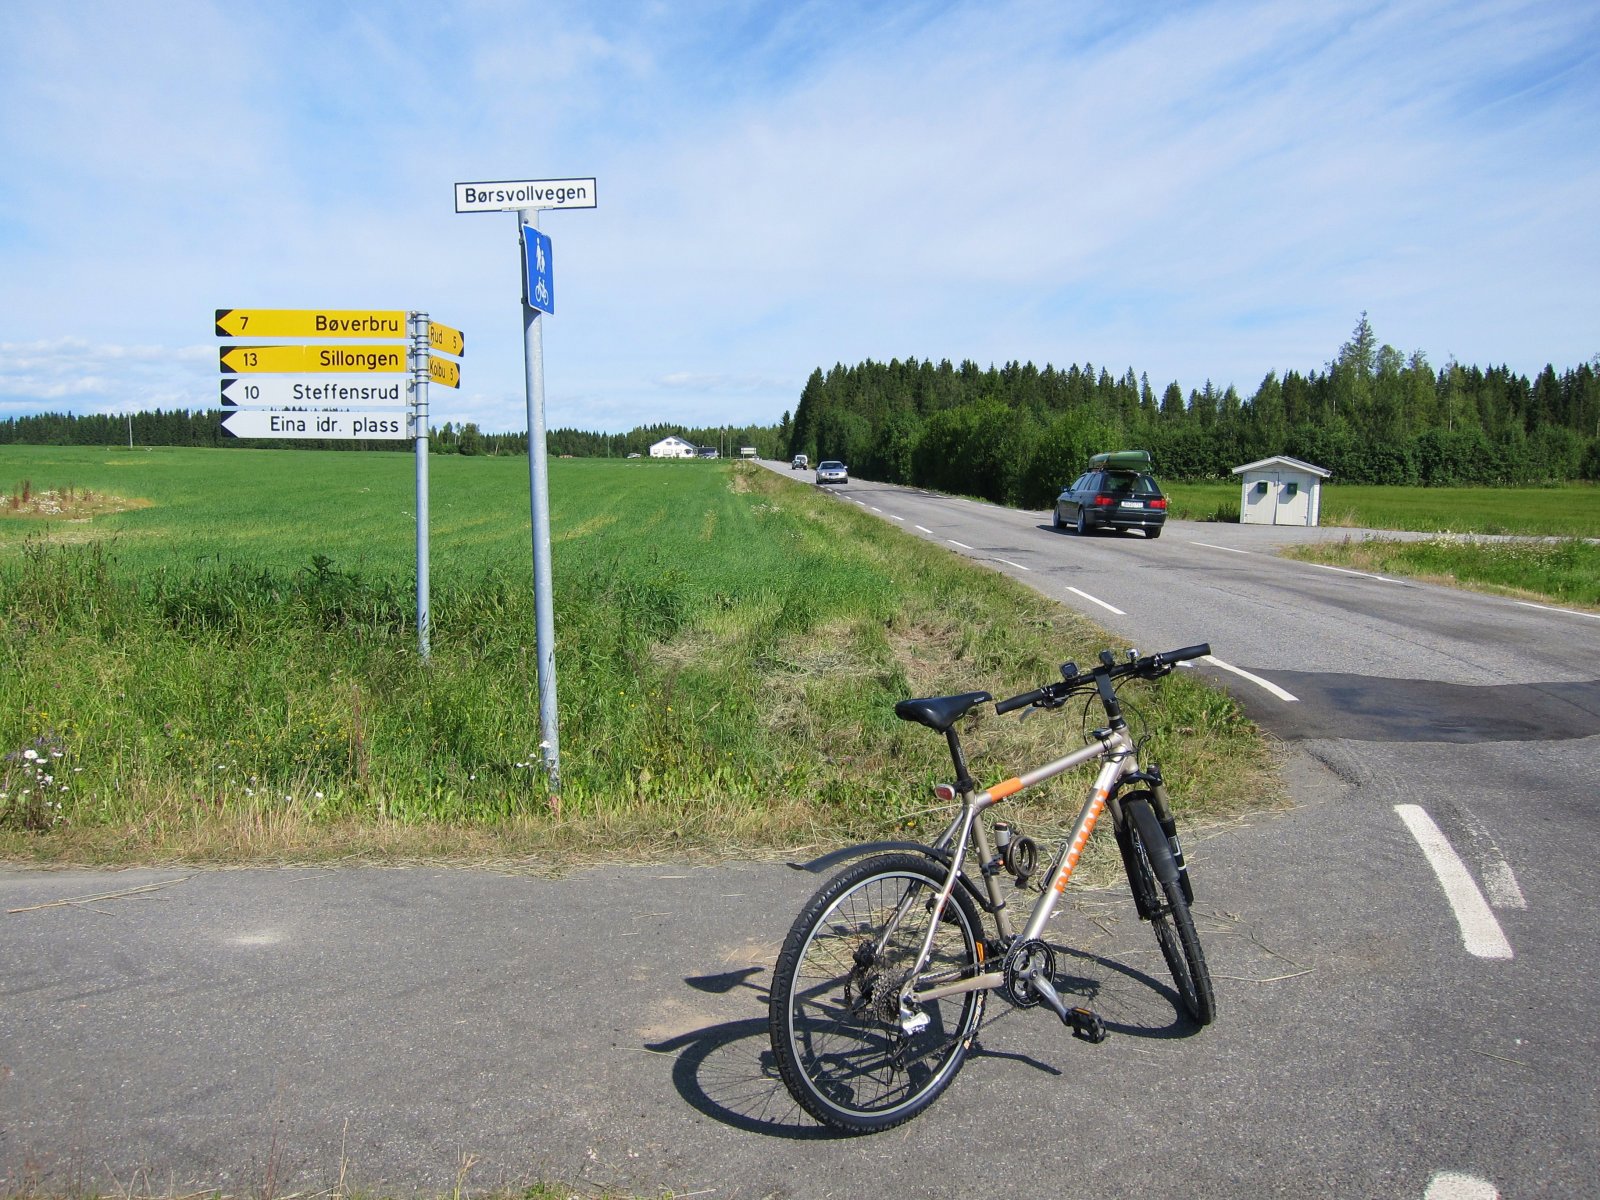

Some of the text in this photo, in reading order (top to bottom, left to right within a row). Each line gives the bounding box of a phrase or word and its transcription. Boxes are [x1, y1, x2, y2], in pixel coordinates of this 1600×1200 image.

[465, 185, 586, 204] Børsvollvegen
[240, 315, 398, 331] 7 Bøverbru
[430, 326, 457, 349] Rud 5
[243, 350, 399, 369] 13 Sillongen
[429, 360, 454, 381] Kolbu 5
[244, 384, 399, 400] 10 Steffensrud
[270, 416, 399, 436] Eina idr. plass
